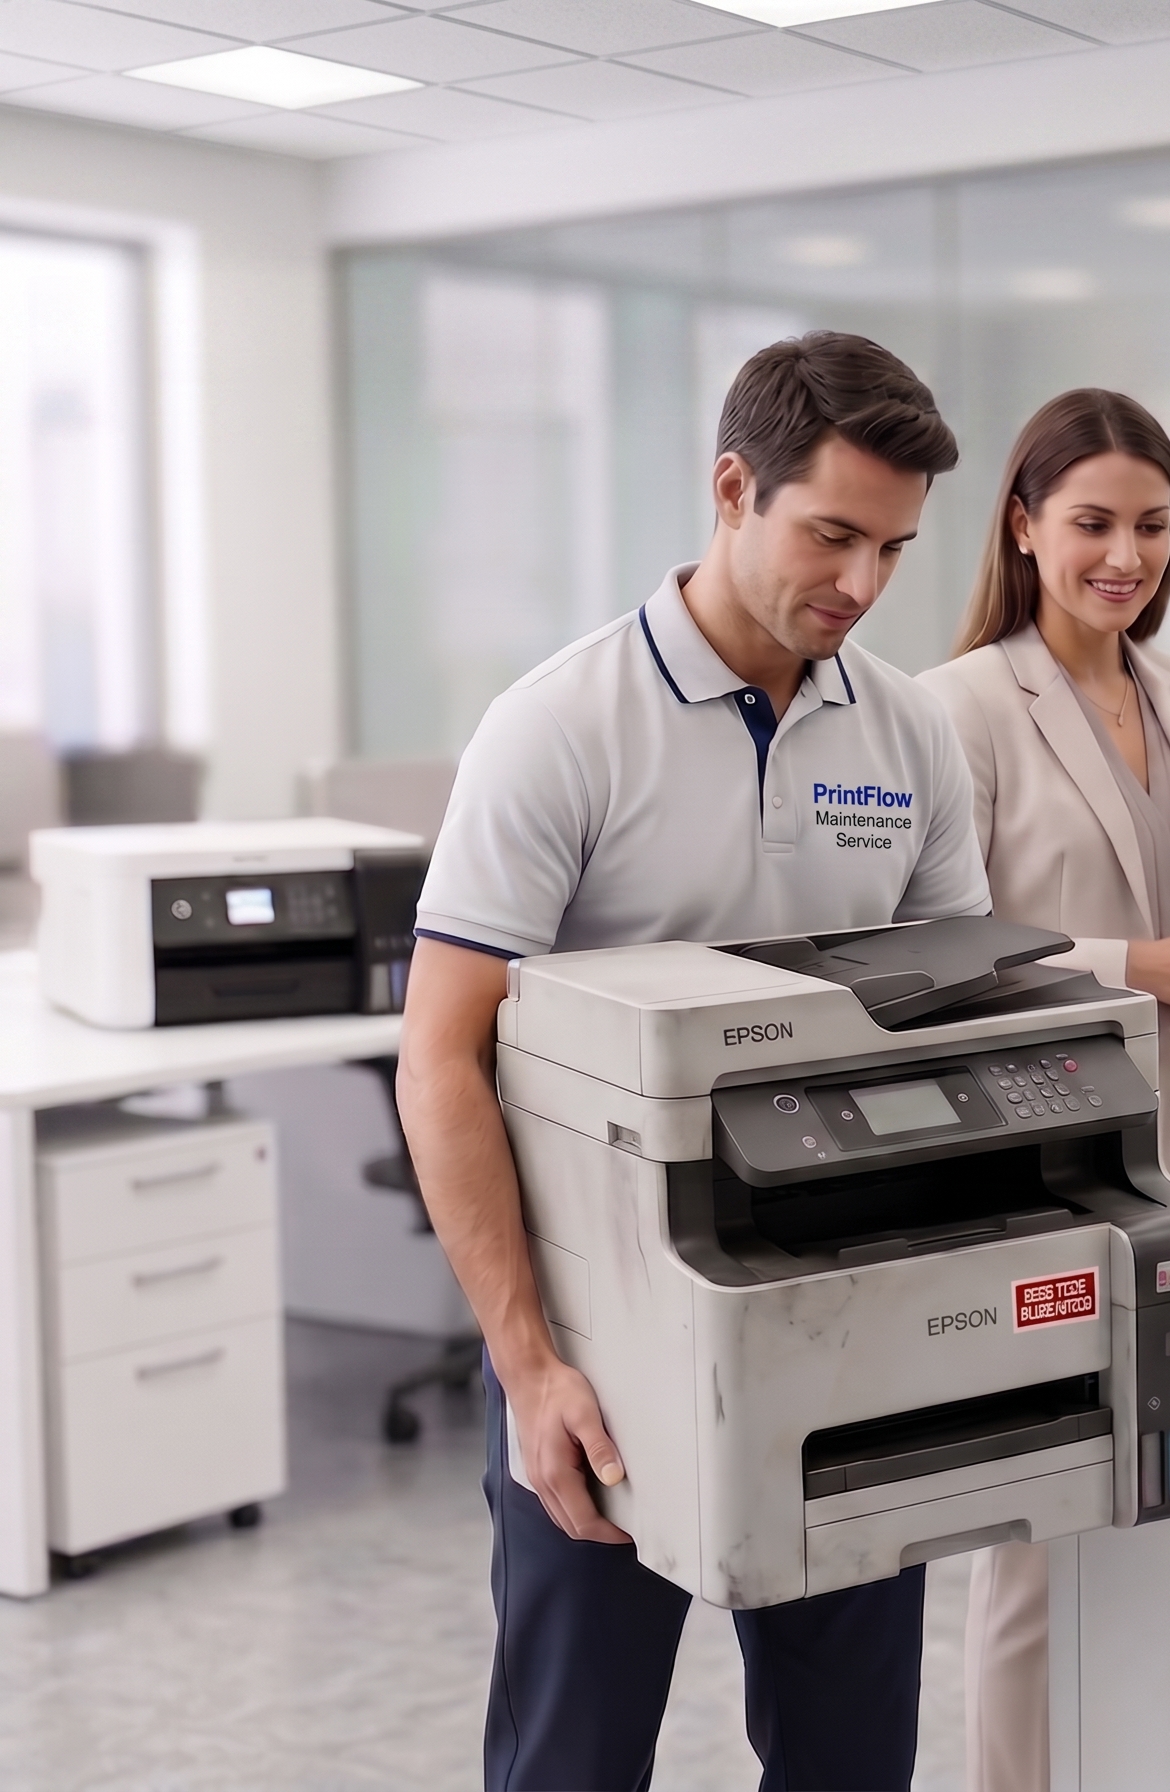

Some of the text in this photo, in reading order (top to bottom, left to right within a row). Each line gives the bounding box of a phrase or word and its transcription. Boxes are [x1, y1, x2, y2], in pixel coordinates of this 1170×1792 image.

[813, 783, 913, 808] PrintFlow
[815, 810, 912, 829] Maintenance
[836, 832, 892, 849] Service
[723, 1021, 793, 1046] EPSON
[927, 1306, 997, 1336] EPSON
